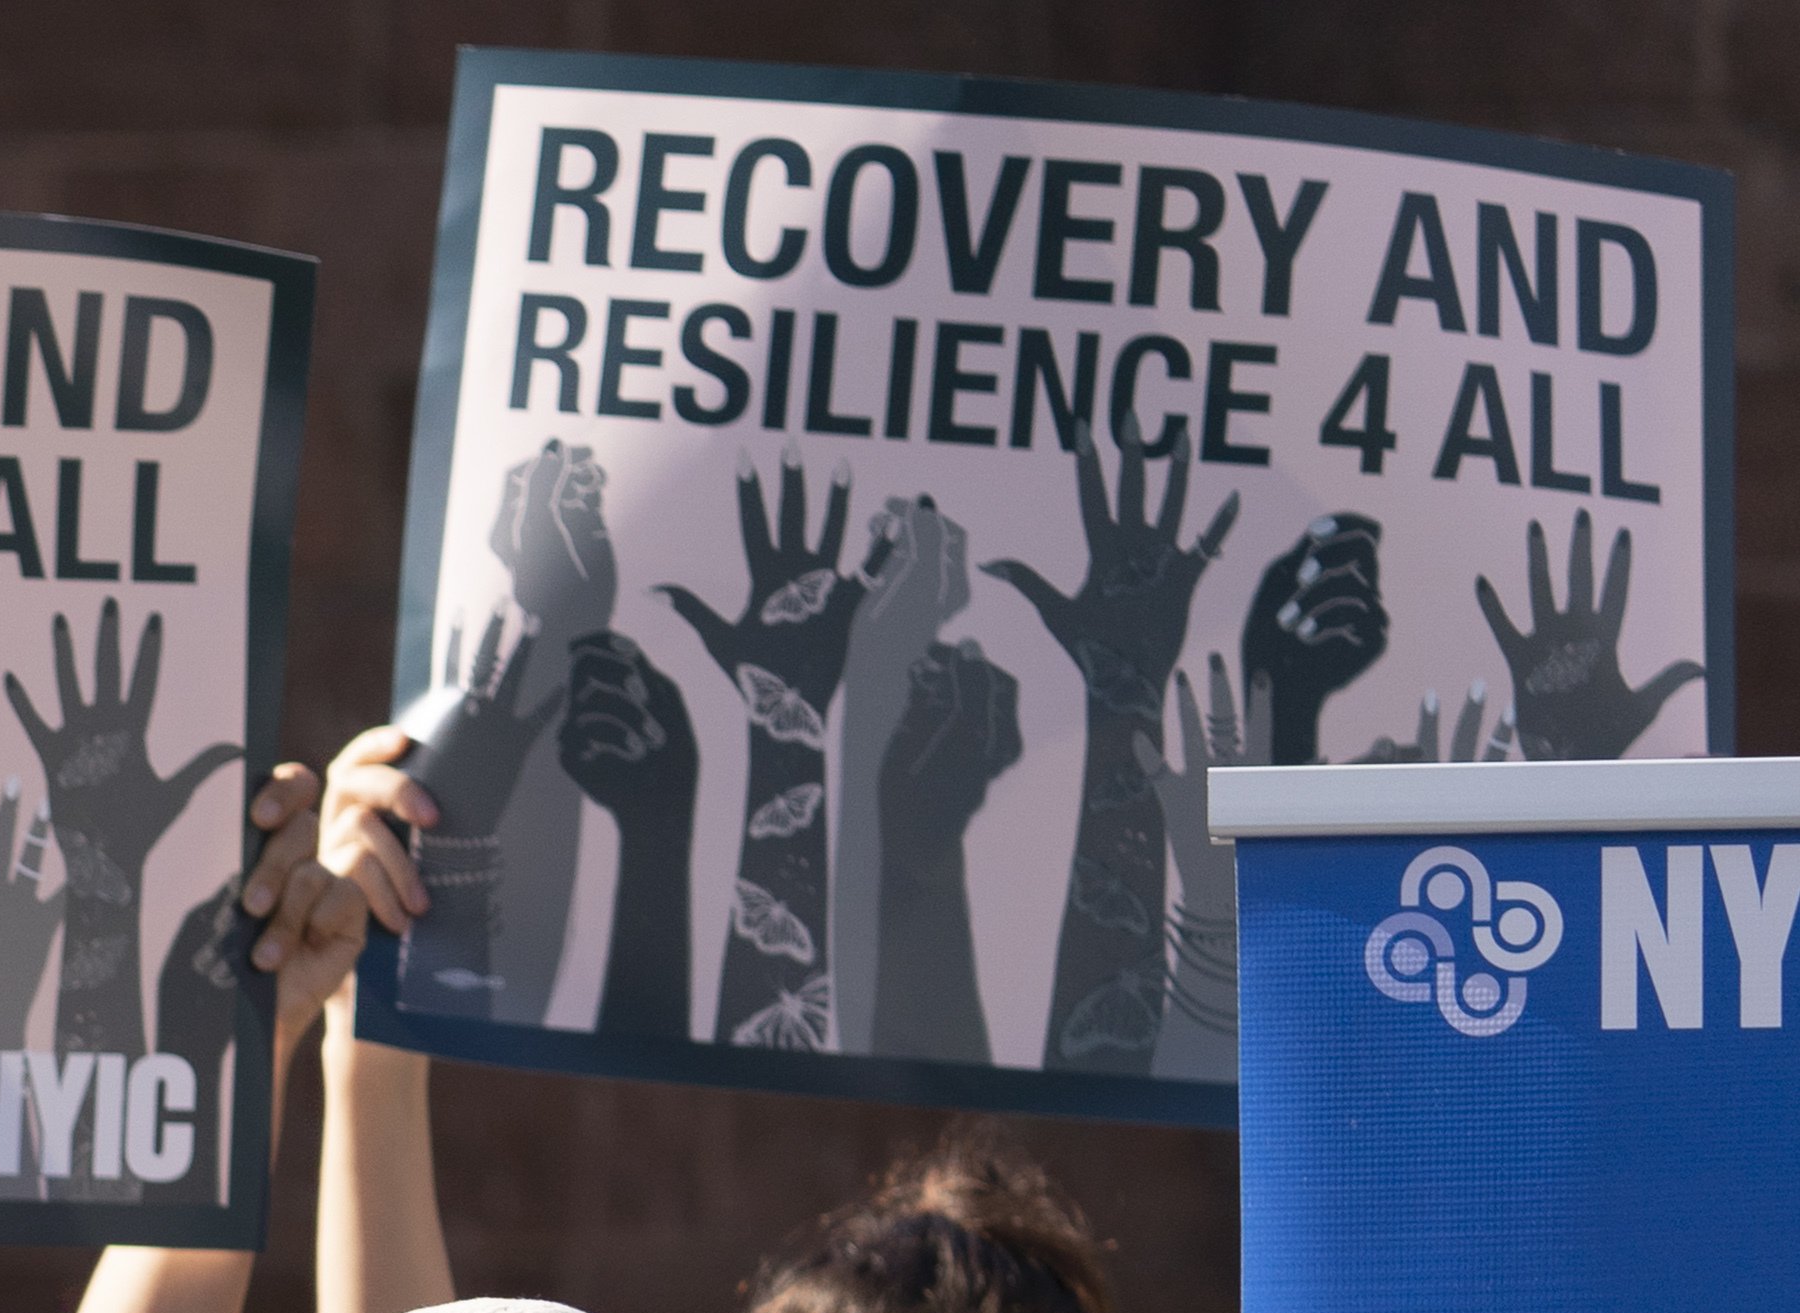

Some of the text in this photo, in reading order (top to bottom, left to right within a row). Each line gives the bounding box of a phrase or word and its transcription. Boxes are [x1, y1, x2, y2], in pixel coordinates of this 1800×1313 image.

[526, 126, 1660, 358] RECOVERY AND
[506, 293, 1663, 507] RESILIENCE 4 ALL
[1600, 845, 1800, 1030] NY
